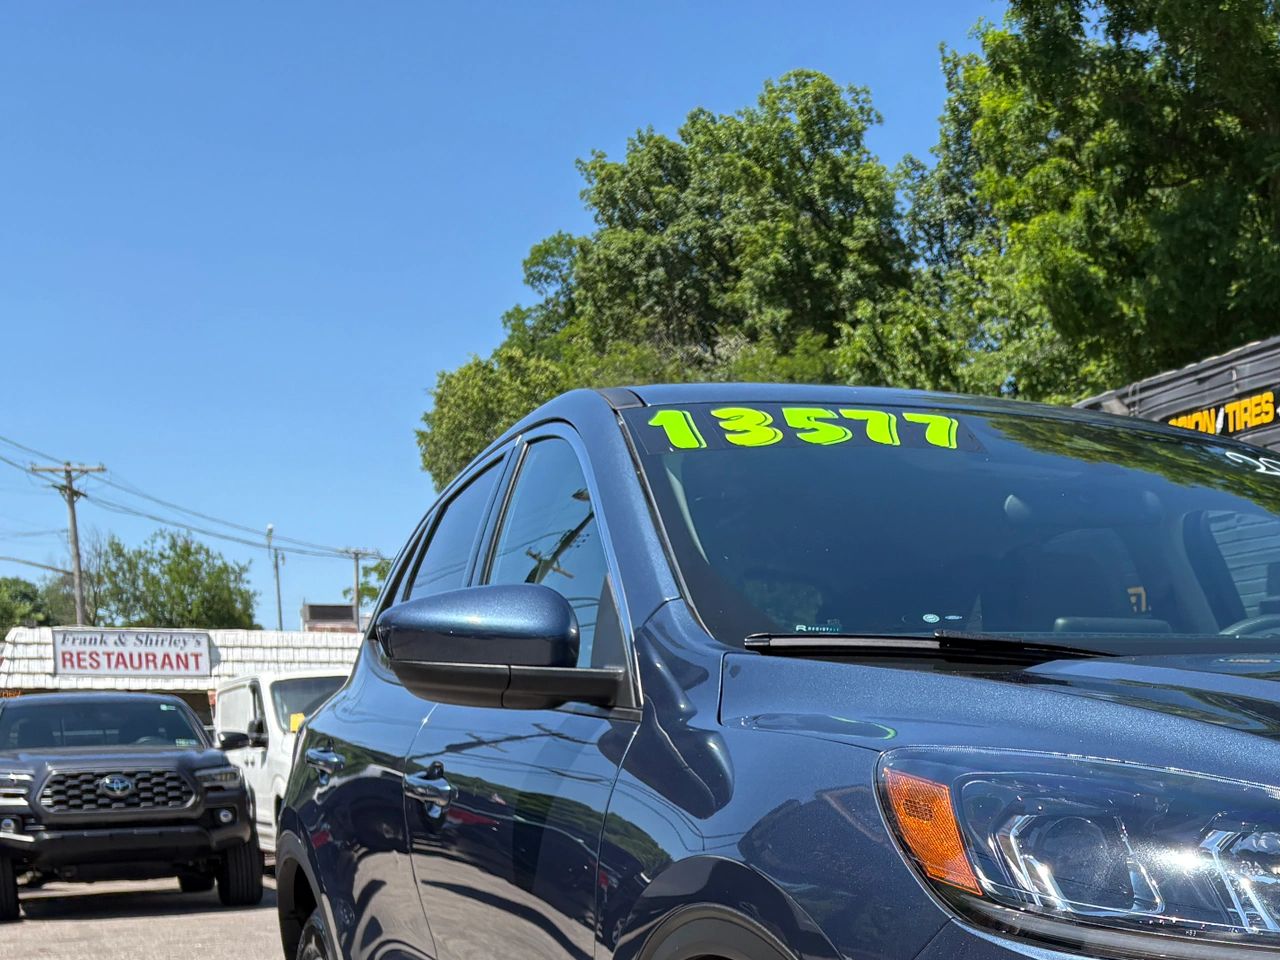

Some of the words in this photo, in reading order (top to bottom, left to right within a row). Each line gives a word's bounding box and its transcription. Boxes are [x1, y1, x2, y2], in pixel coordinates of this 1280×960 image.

[1224, 391, 1275, 433] TIRES
[648, 407, 959, 449] 13577
[61, 632, 108, 647] Frank
[114, 633, 126, 647] &
[133, 634, 203, 650] Shirley's
[61, 651, 203, 671] RESTAURANT
